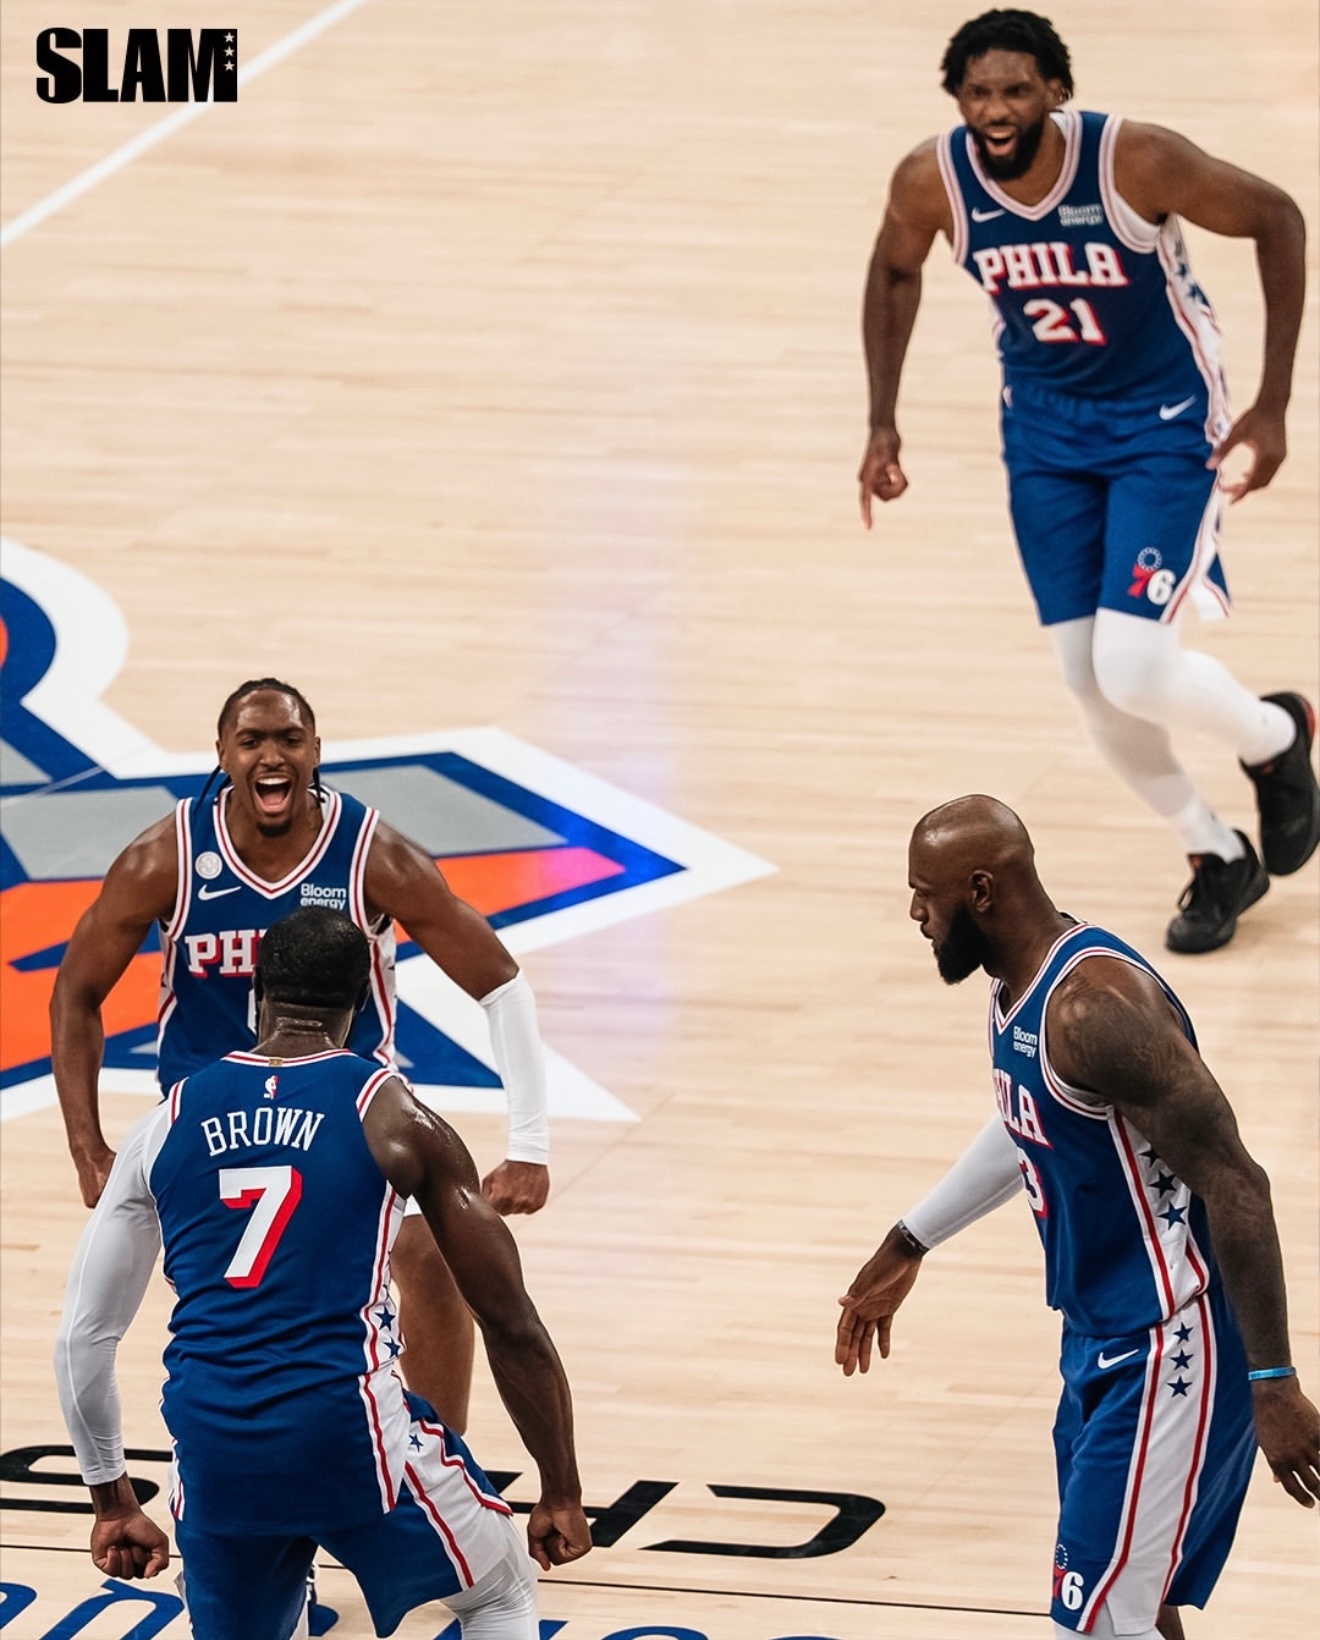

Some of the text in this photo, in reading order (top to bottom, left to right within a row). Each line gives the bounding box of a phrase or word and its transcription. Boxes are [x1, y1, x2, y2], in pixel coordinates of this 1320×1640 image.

[973, 242, 1130, 296] PHILA
[1023, 298, 1107, 346] 21
[1126, 563, 1177, 606] 76
[301, 883, 347, 898] Bloom
[301, 897, 346, 910] energy
[184, 929, 269, 978] PH
[1013, 1026, 1037, 1046] Bloom
[1013, 1041, 1037, 1058] energy
[201, 1107, 325, 1157] BROWN
[218, 1165, 303, 1289] 7
